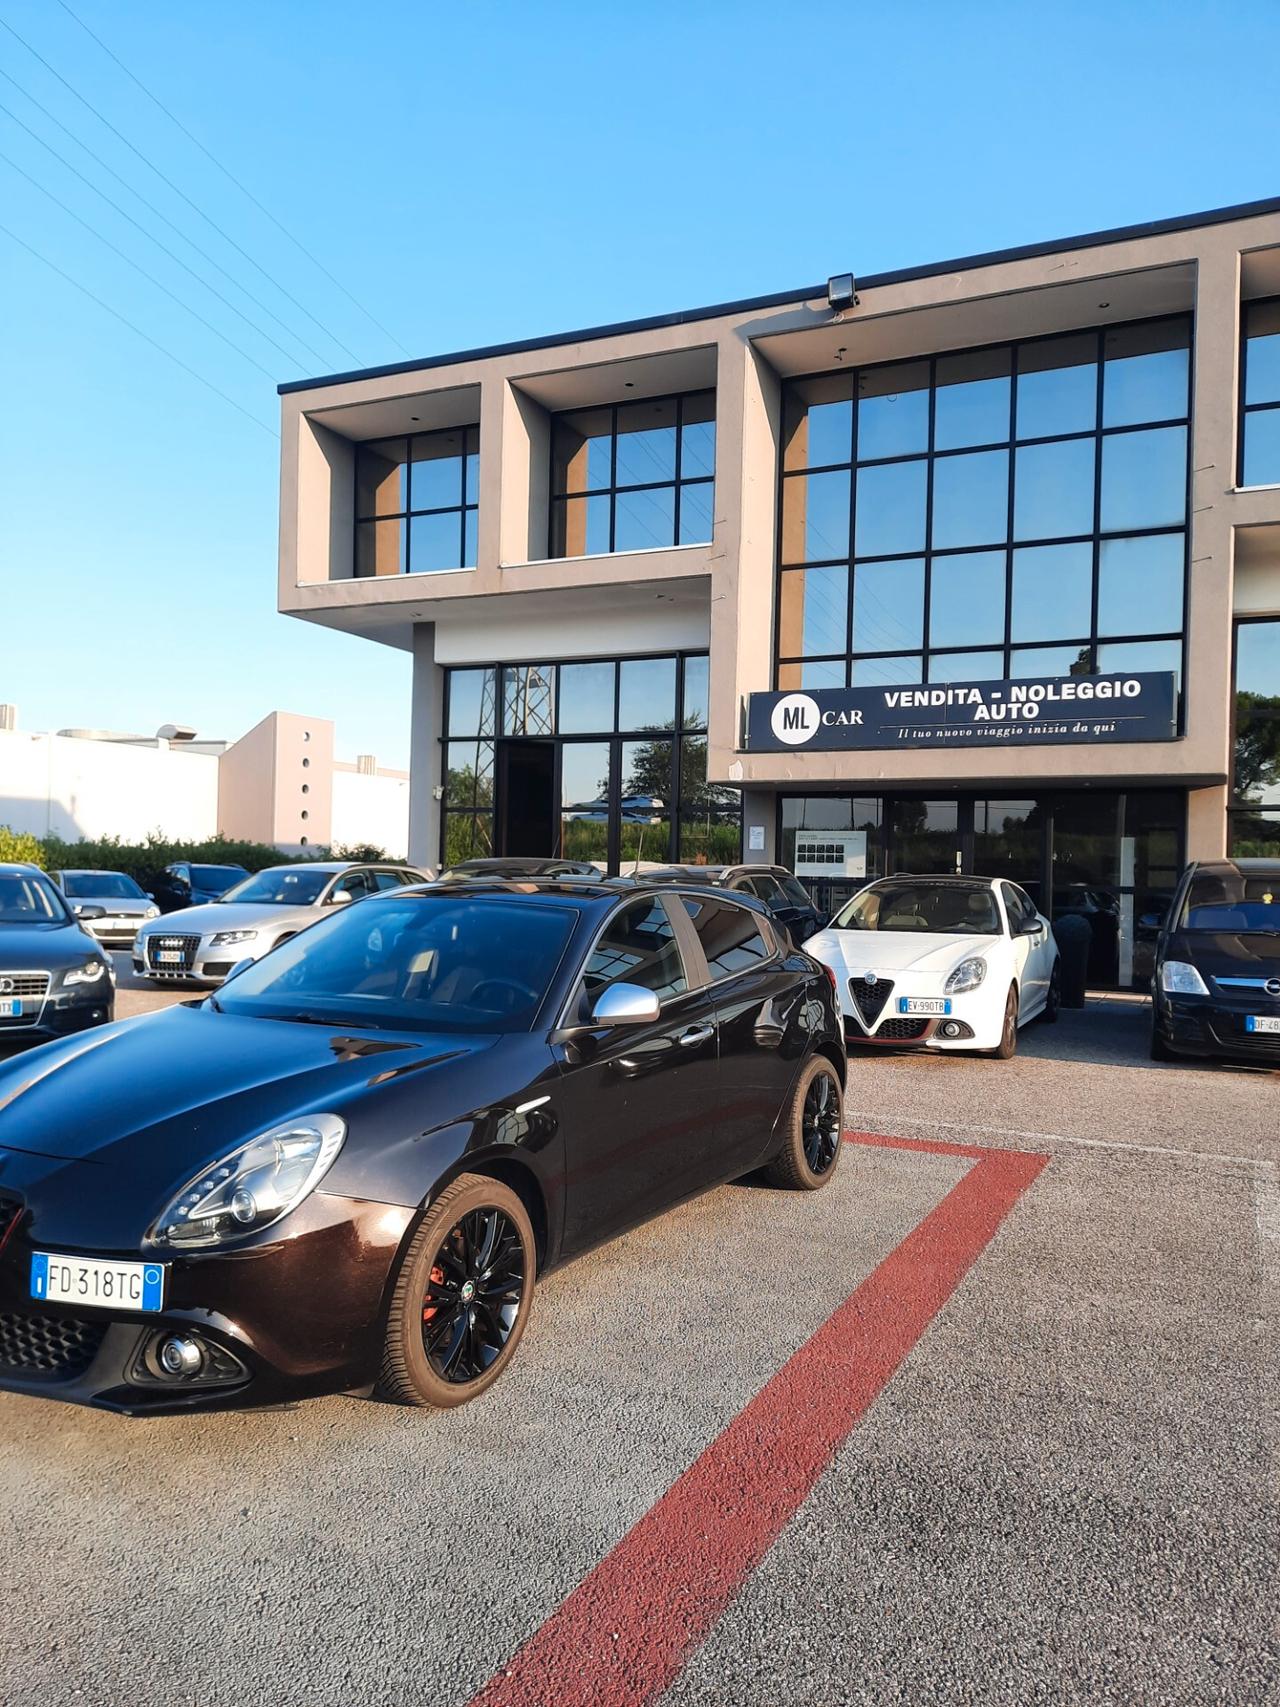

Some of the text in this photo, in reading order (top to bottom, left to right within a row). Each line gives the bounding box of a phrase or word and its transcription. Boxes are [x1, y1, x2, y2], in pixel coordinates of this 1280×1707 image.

[884, 688, 983, 708] VENDITA
[1011, 680, 1141, 702] NOLEGGIO
[783, 707, 864, 730] ML CAR
[974, 702, 1040, 721] AUTO
[898, 721, 1116, 738] Il tuo nuovo viaggio inizia da qui
